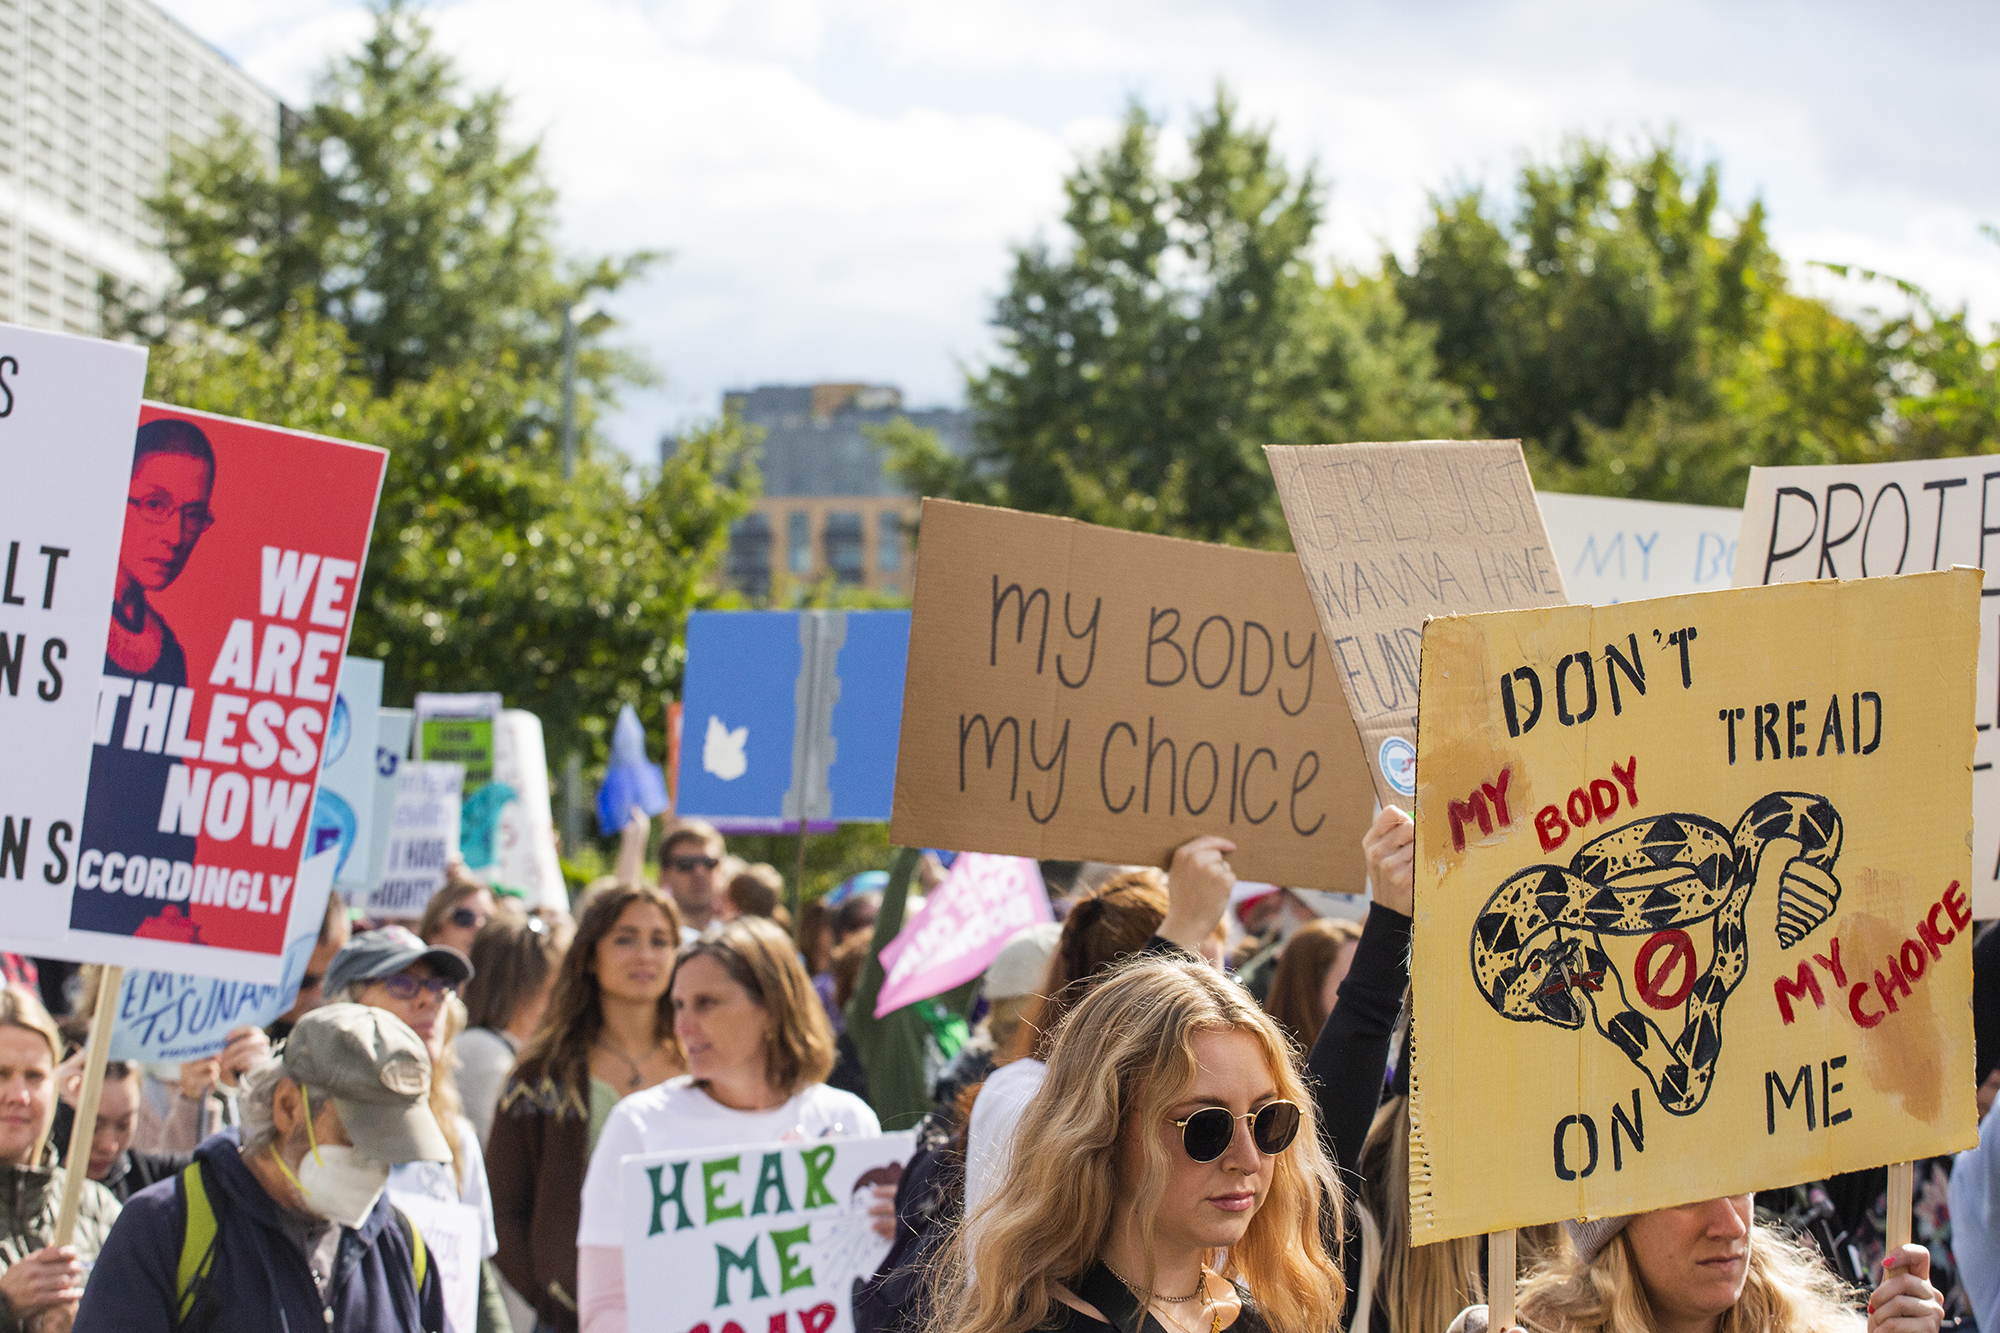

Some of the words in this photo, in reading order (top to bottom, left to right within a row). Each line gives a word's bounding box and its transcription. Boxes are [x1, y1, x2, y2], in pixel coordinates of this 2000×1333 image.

[1289, 459, 1433, 552] GIRLS
[1446, 459, 1531, 536] JUST
[3, 541, 70, 610] LT
[260, 546, 358, 628] WE
[1303, 550, 1471, 623] WANNA
[1474, 546, 1561, 605] HAVE
[1573, 529, 1659, 583] MY
[208, 617, 342, 702] ARE
[1501, 627, 1697, 737] DON'T
[93, 674, 325, 776] THLESS
[1718, 691, 1883, 765] TREAD
[157, 762, 312, 850] NOW
[1447, 767, 1514, 853] MY
[1534, 755, 1641, 854] BODY
[77, 848, 293, 915] CCORDINGLY
[1774, 937, 1847, 1026] MY
[1849, 880, 1973, 1029] CHOICE
[1553, 1089, 1645, 1182] ON
[1765, 1055, 1853, 1135] ME
[645, 1144, 838, 1238] HEAR
[713, 1223, 815, 1310] ME
